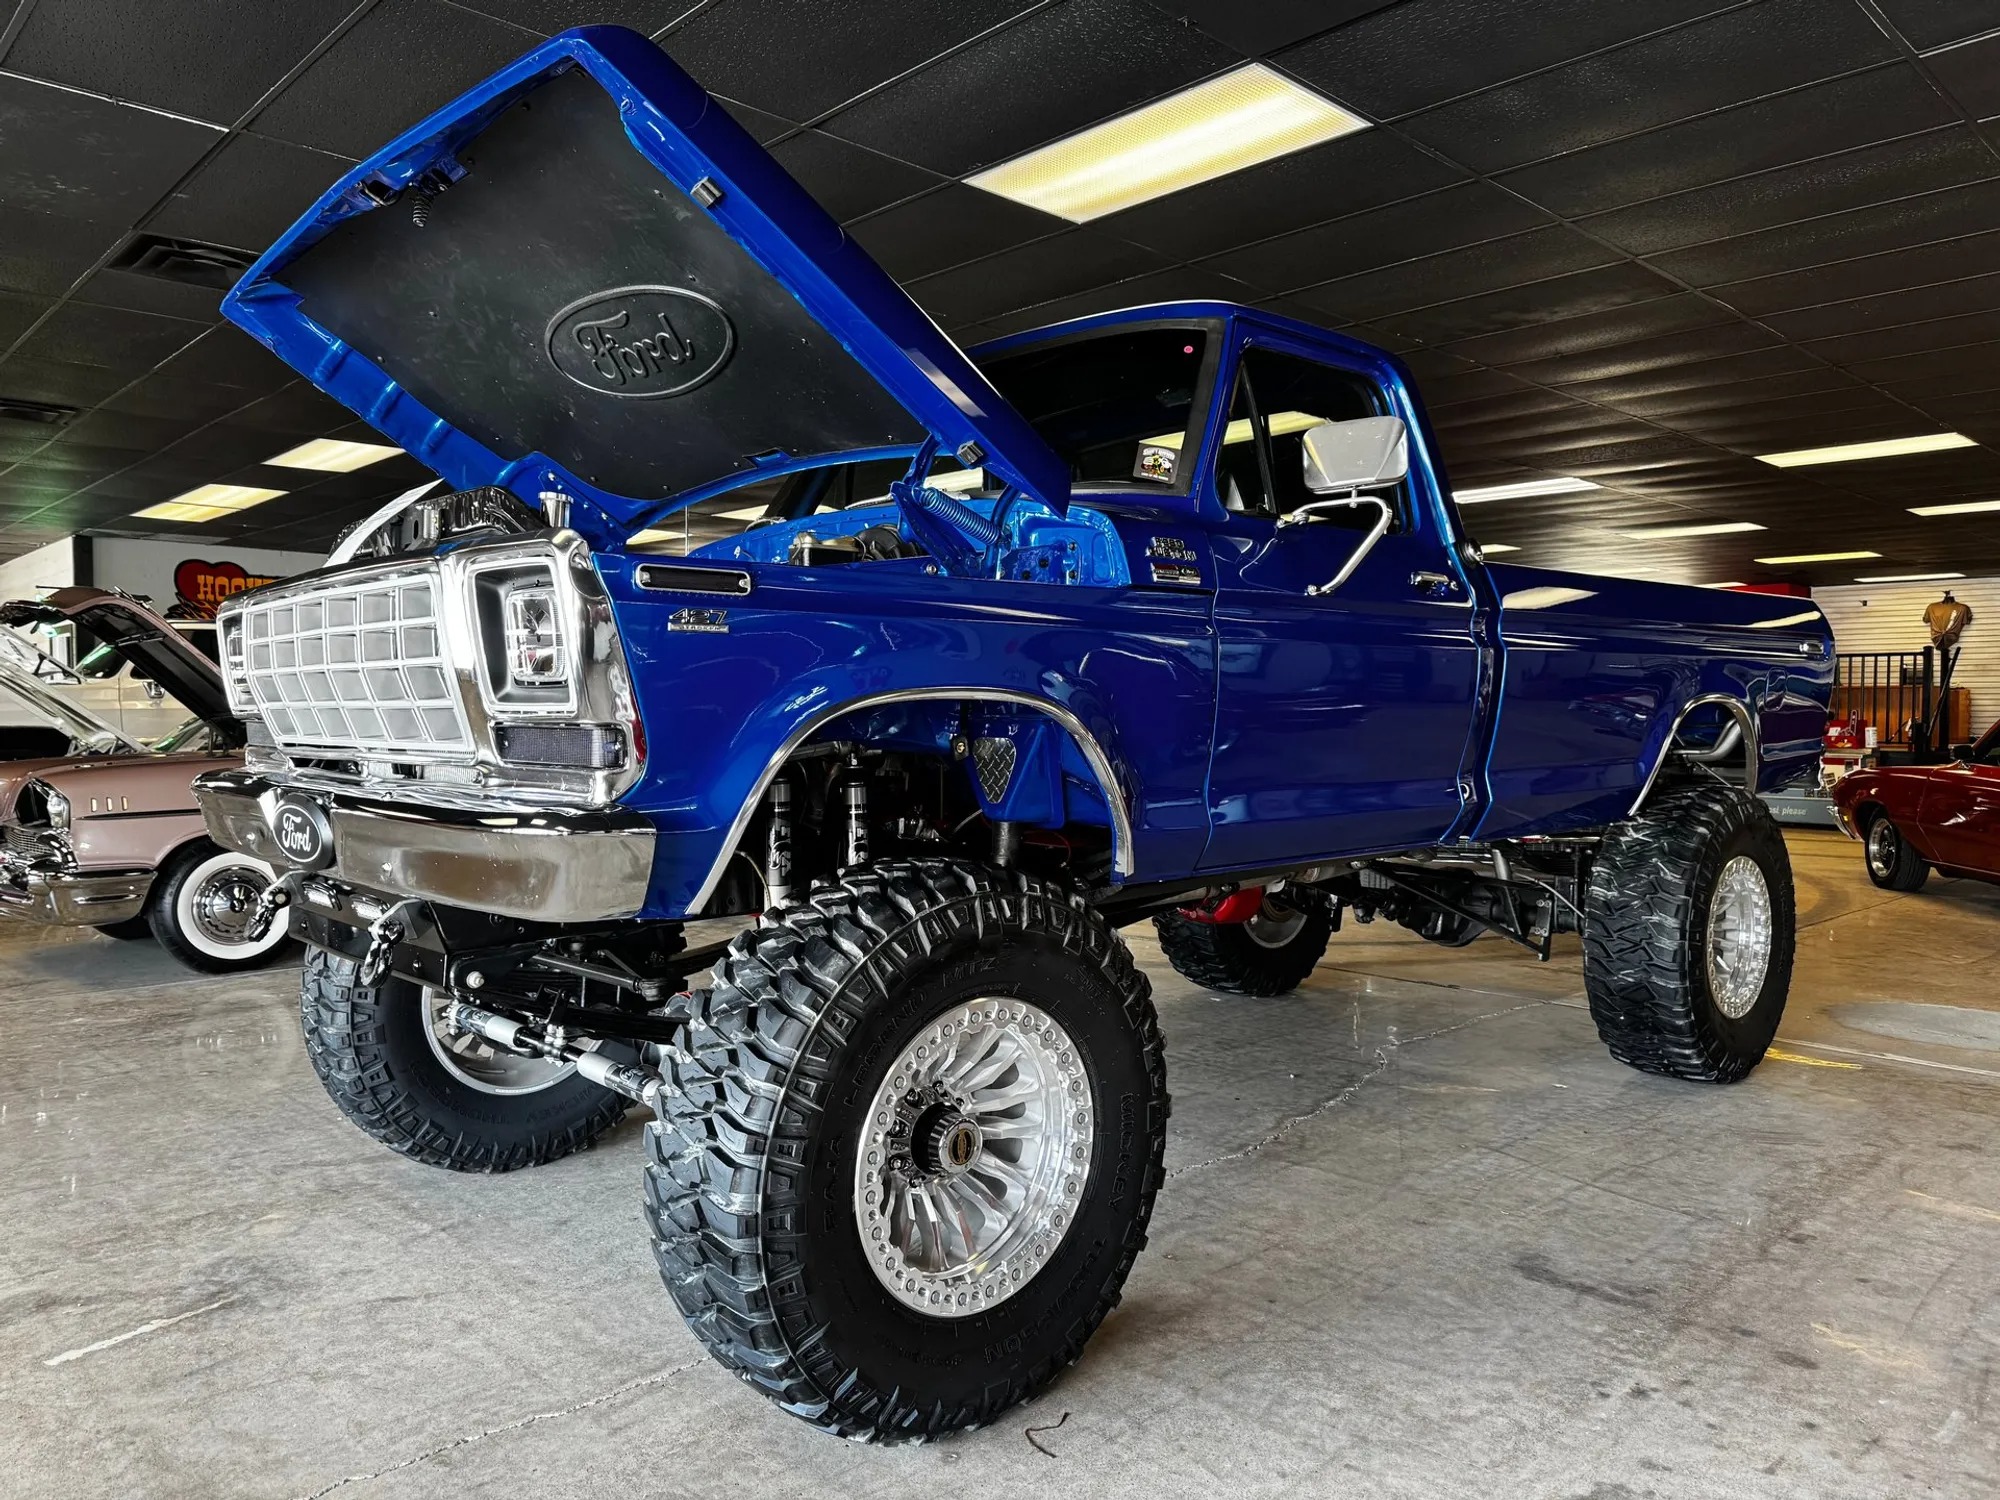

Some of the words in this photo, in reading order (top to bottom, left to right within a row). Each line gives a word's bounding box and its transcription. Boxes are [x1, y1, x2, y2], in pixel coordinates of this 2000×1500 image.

[572, 309, 695, 385] Ford
[669, 608, 727, 624] 427
[282, 812, 312, 852] Ford
